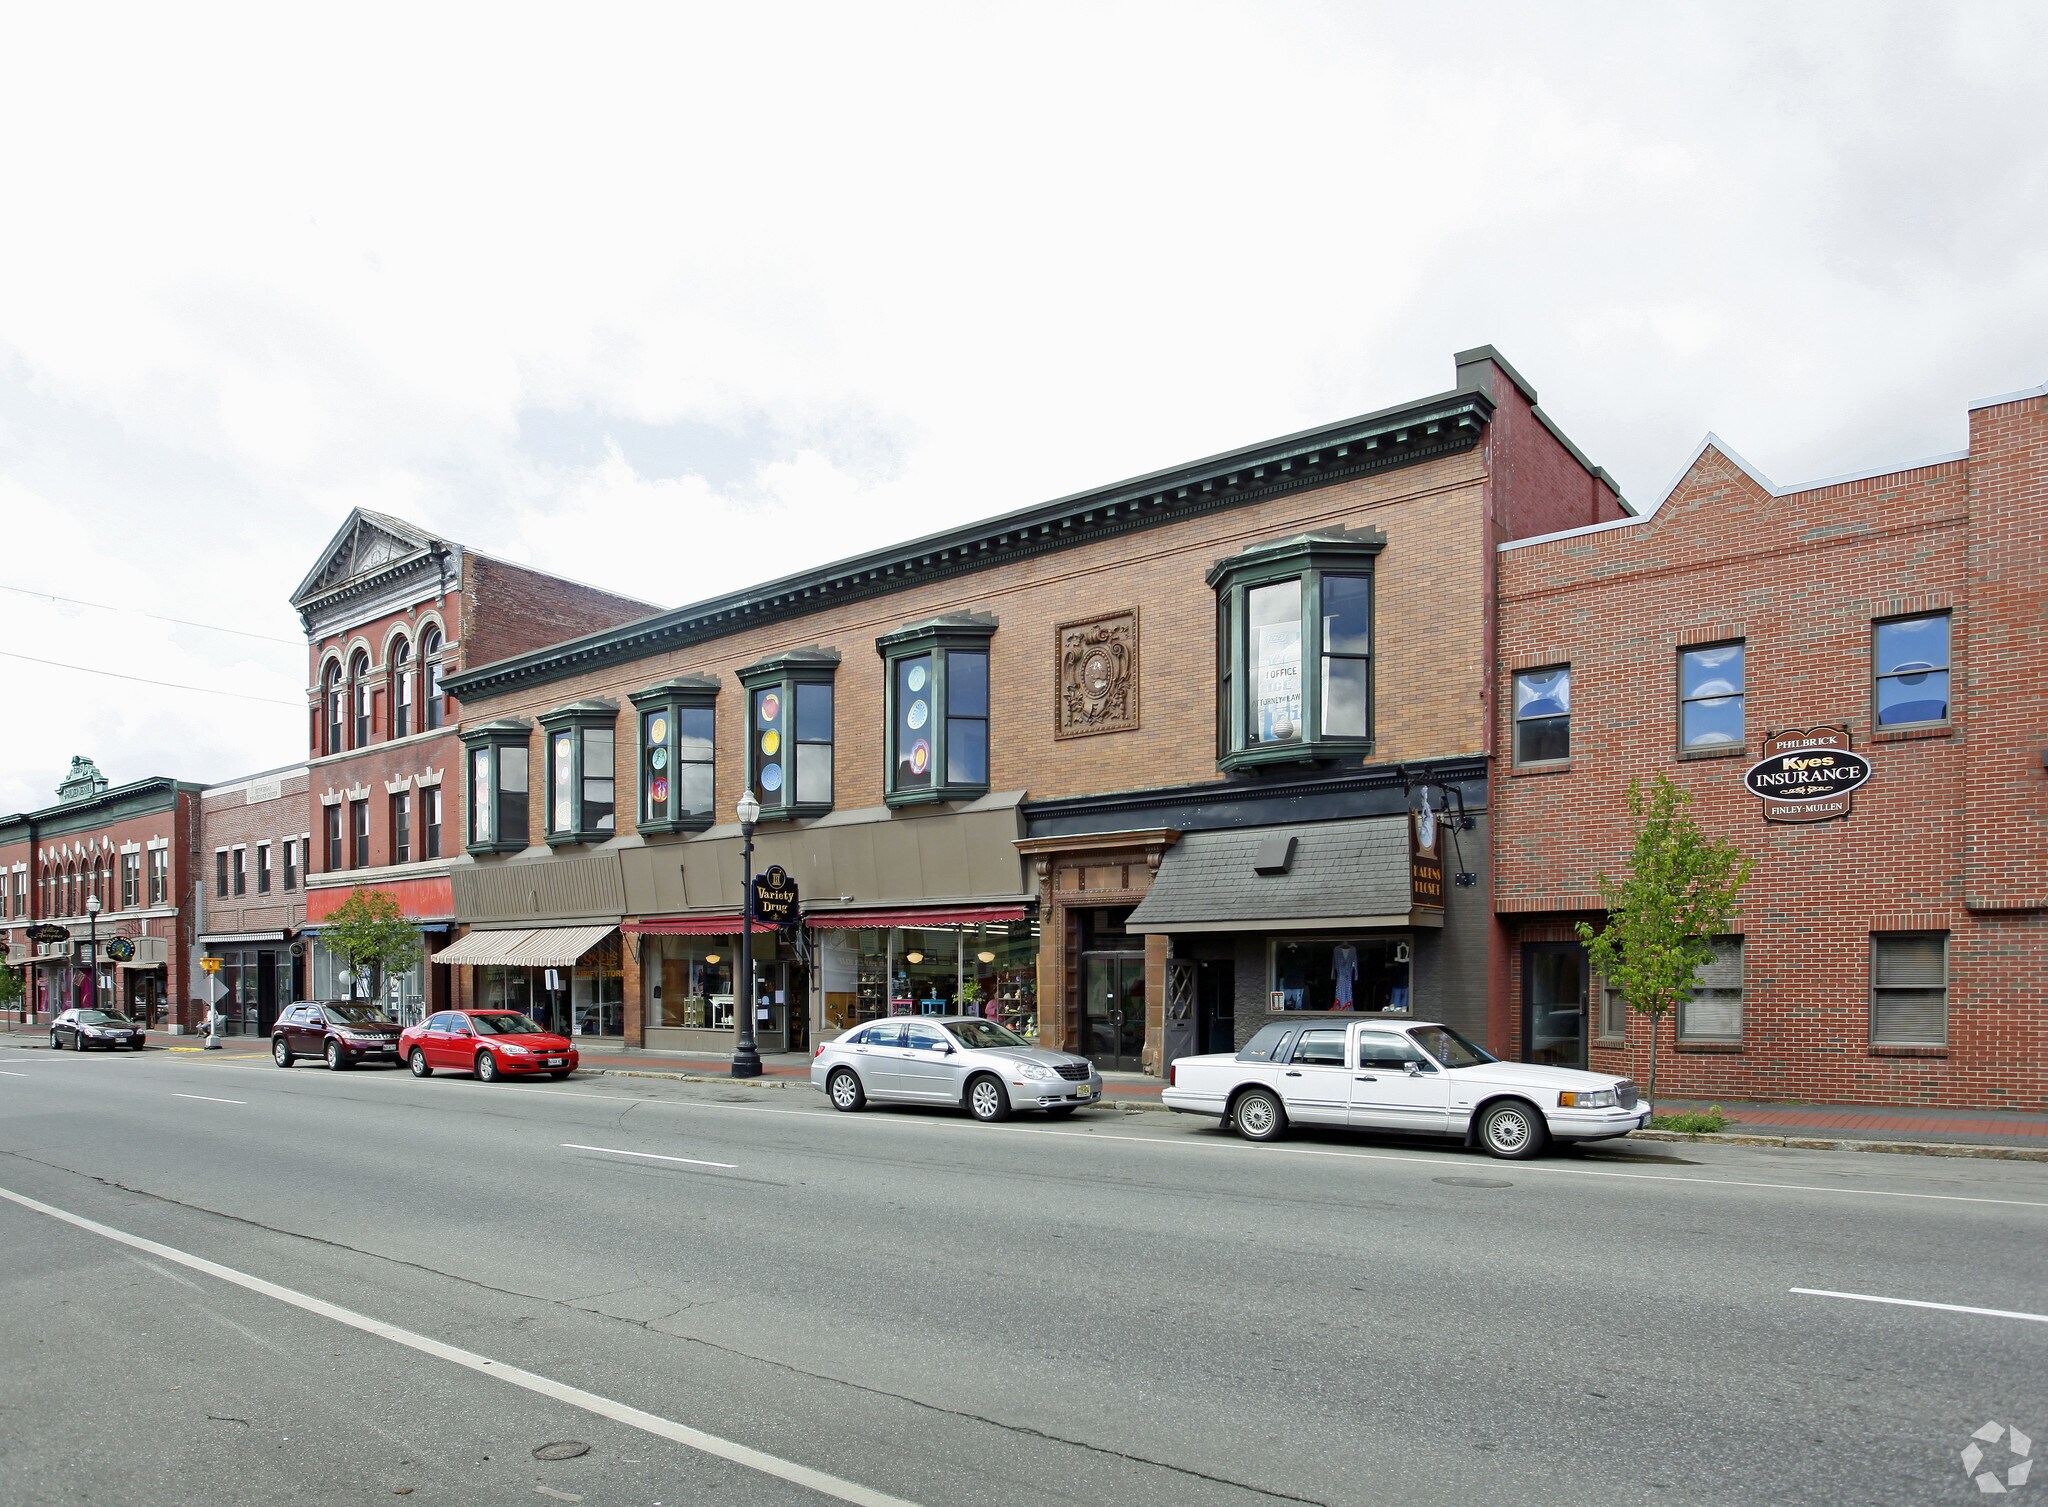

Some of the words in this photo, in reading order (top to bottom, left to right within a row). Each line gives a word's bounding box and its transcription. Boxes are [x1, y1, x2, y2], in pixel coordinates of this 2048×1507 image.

[1270, 667, 1297, 679] OFFICE
[1287, 693, 1301, 702] LAW
[1776, 735, 1838, 750] PHILBRICK
[1782, 756, 1835, 771] Kyes
[1756, 765, 1861, 787] INSURANCE
[1771, 802, 1843, 815] FINLEY-MULLEN
[756, 885, 795, 903] Variety
[762, 901, 788, 914] Drug
